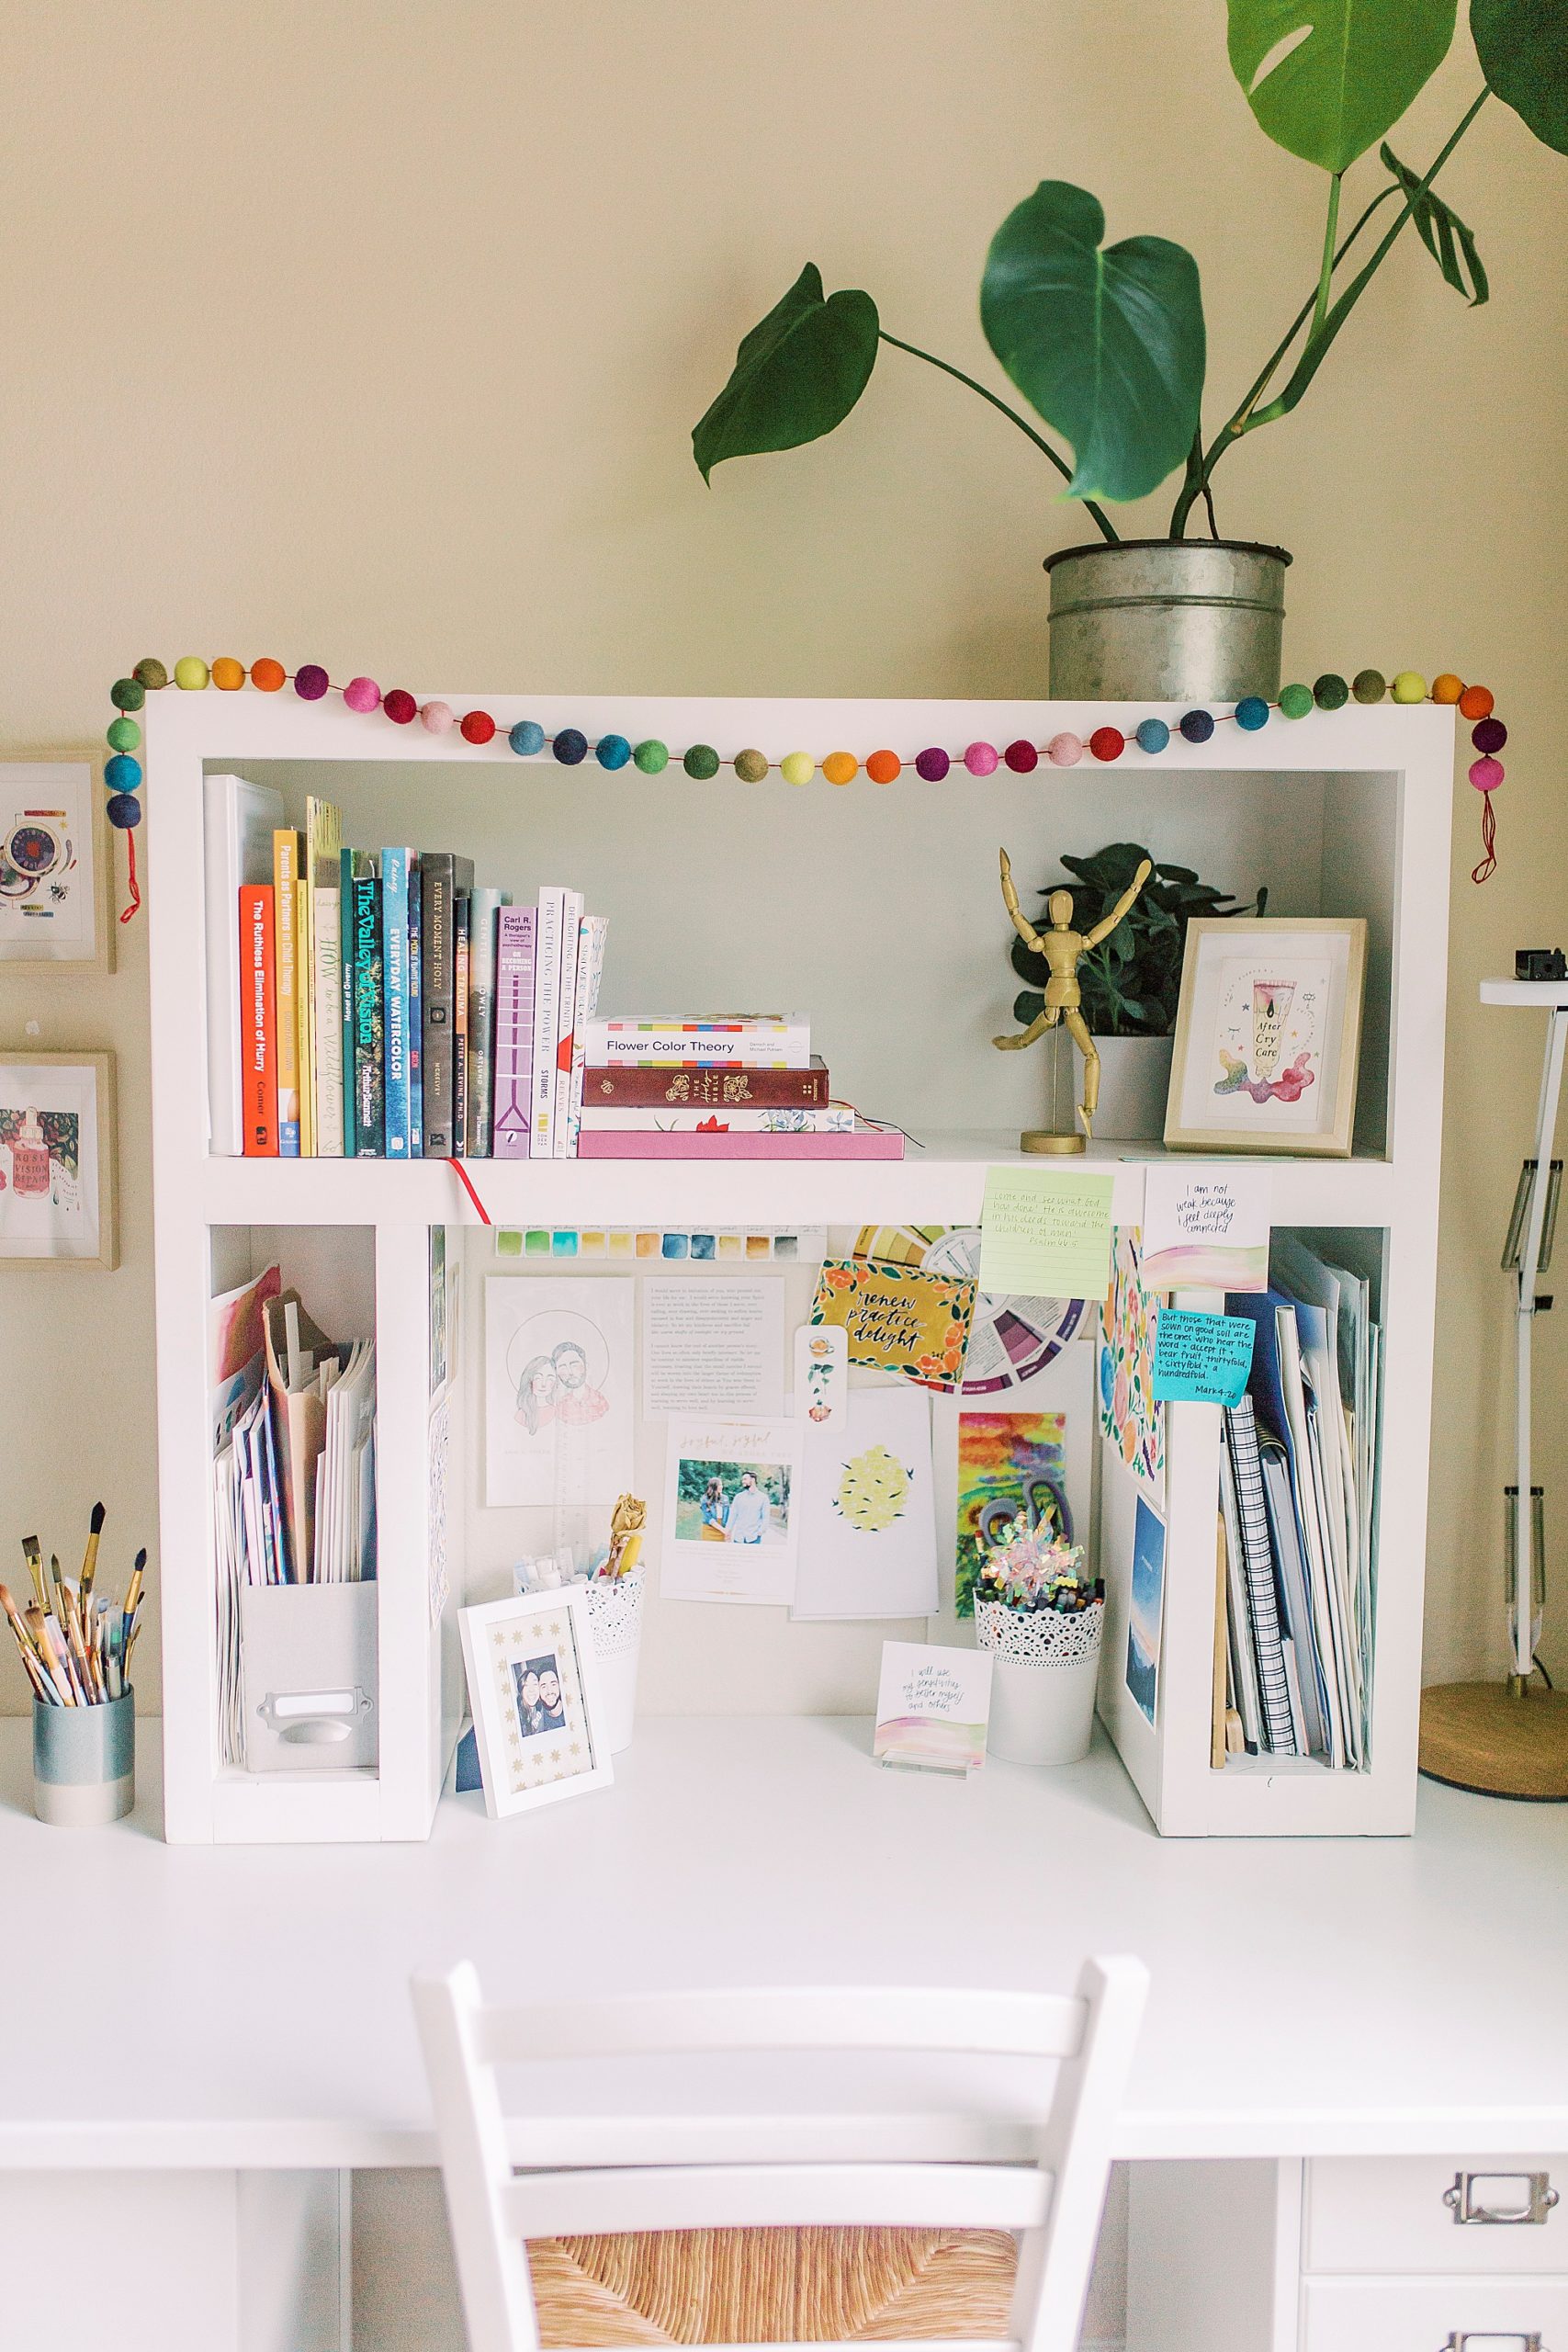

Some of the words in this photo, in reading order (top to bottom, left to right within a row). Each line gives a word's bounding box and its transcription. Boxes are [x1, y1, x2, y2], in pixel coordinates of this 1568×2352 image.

[280, 844, 292, 879] Parents
[281, 880, 290, 892] as
[356, 881, 374, 910] The
[434, 881, 442, 913] EVERY
[254, 900, 265, 920] The
[281, 893, 293, 931] Partners
[282, 933, 292, 941] in
[411, 926, 419, 938] THE
[434, 915, 442, 959] MOMENT
[479, 918, 489, 959] GENTLE
[503, 923, 532, 932] Rogers
[542, 901, 555, 977] PRACTICING
[565, 906, 575, 960] DELIGHTING
[254, 922, 265, 967] Ruthless
[355, 910, 374, 969] Valley
[411, 939, 419, 955] MOON
[457, 928, 466, 972] HEALING
[283, 943, 294, 965] Child
[319, 937, 341, 985] HOW
[389, 928, 401, 992] EVERYDAY
[344, 963, 353, 990] Giverny
[434, 962, 442, 989] HOLY
[565, 963, 573, 972] IN
[281, 965, 294, 996] Therapy
[359, 972, 374, 990] of
[564, 975, 572, 993] THE
[254, 970, 265, 1028] Elimination
[344, 991, 351, 1001] at
[457, 975, 466, 1017] TRAUMA
[542, 981, 553, 1006] THE
[359, 990, 374, 1044] Vision
[563, 996, 571, 1029] TRINITY
[255, 1030, 265, 1042] of
[389, 995, 402, 1080] WATERCOLOR
[541, 1011, 552, 1052] POWER
[1257, 1022, 1281, 1033] After
[457, 1038, 465, 1059] PETER
[606, 1040, 649, 1051] Flower
[652, 1041, 686, 1051] Color
[690, 1041, 735, 1054] Theory
[1255, 1047, 1277, 1057] Care
[1256, 1034, 1277, 1047] Cry
[253, 1043, 266, 1071] Hurry
[457, 1061, 465, 1070] A.
[477, 1049, 485, 1085] ORTLUND
[319, 1034, 342, 1119] Wildflower
[361, 1066, 372, 1092] Arthur
[457, 1072, 465, 1099] LEVINE,
[539, 1069, 549, 1099] STORMS
[700, 1069, 712, 1102] Holy
[257, 1081, 266, 1114] Comer
[558, 1080, 566, 1112] REEVES
[361, 1092, 373, 1127] Bennett
[457, 1100, 465, 1123] PH.D.
[15, 1164, 47, 1174] VISION
[16, 1153, 45, 1162] ROSE
[1193, 1184, 1209, 1194] am
[1213, 1183, 1228, 1195] not
[1176, 1198, 1197, 1213] weak
[1200, 1196, 1236, 1209] because
[1183, 1211, 1201, 1227] feel
[1203, 1209, 1234, 1227] deeply
[1186, 1223, 1228, 1234] connected
[858, 1290, 917, 1309] renew
[846, 1306, 928, 1329] practice
[1162, 1313, 1177, 1321] But
[1179, 1315, 1202, 1324] those
[1205, 1317, 1225, 1327] that
[1229, 1322, 1251, 1330] were
[853, 1322, 924, 1353] delight
[1160, 1323, 1182, 1331] sown
[1184, 1325, 1194, 1333] on
[1195, 1326, 1214, 1335] good
[1216, 1329, 1231, 1338] soil
[1158, 1340, 1179, 1349] word
[1190, 1343, 1217, 1353] accept
[1219, 1346, 1227, 1355] it
[1158, 1349, 1179, 1358] bear
[1195, 1335, 1214, 1344] who
[1216, 1337, 1235, 1347] hear
[1237, 1340, 1253, 1350] the
[1157, 1368, 1209, 1379] hundredfold.
[1195, 1385, 1217, 1395] Mark
[919, 1666, 934, 1677] will
[928, 1699, 951, 1713] others
